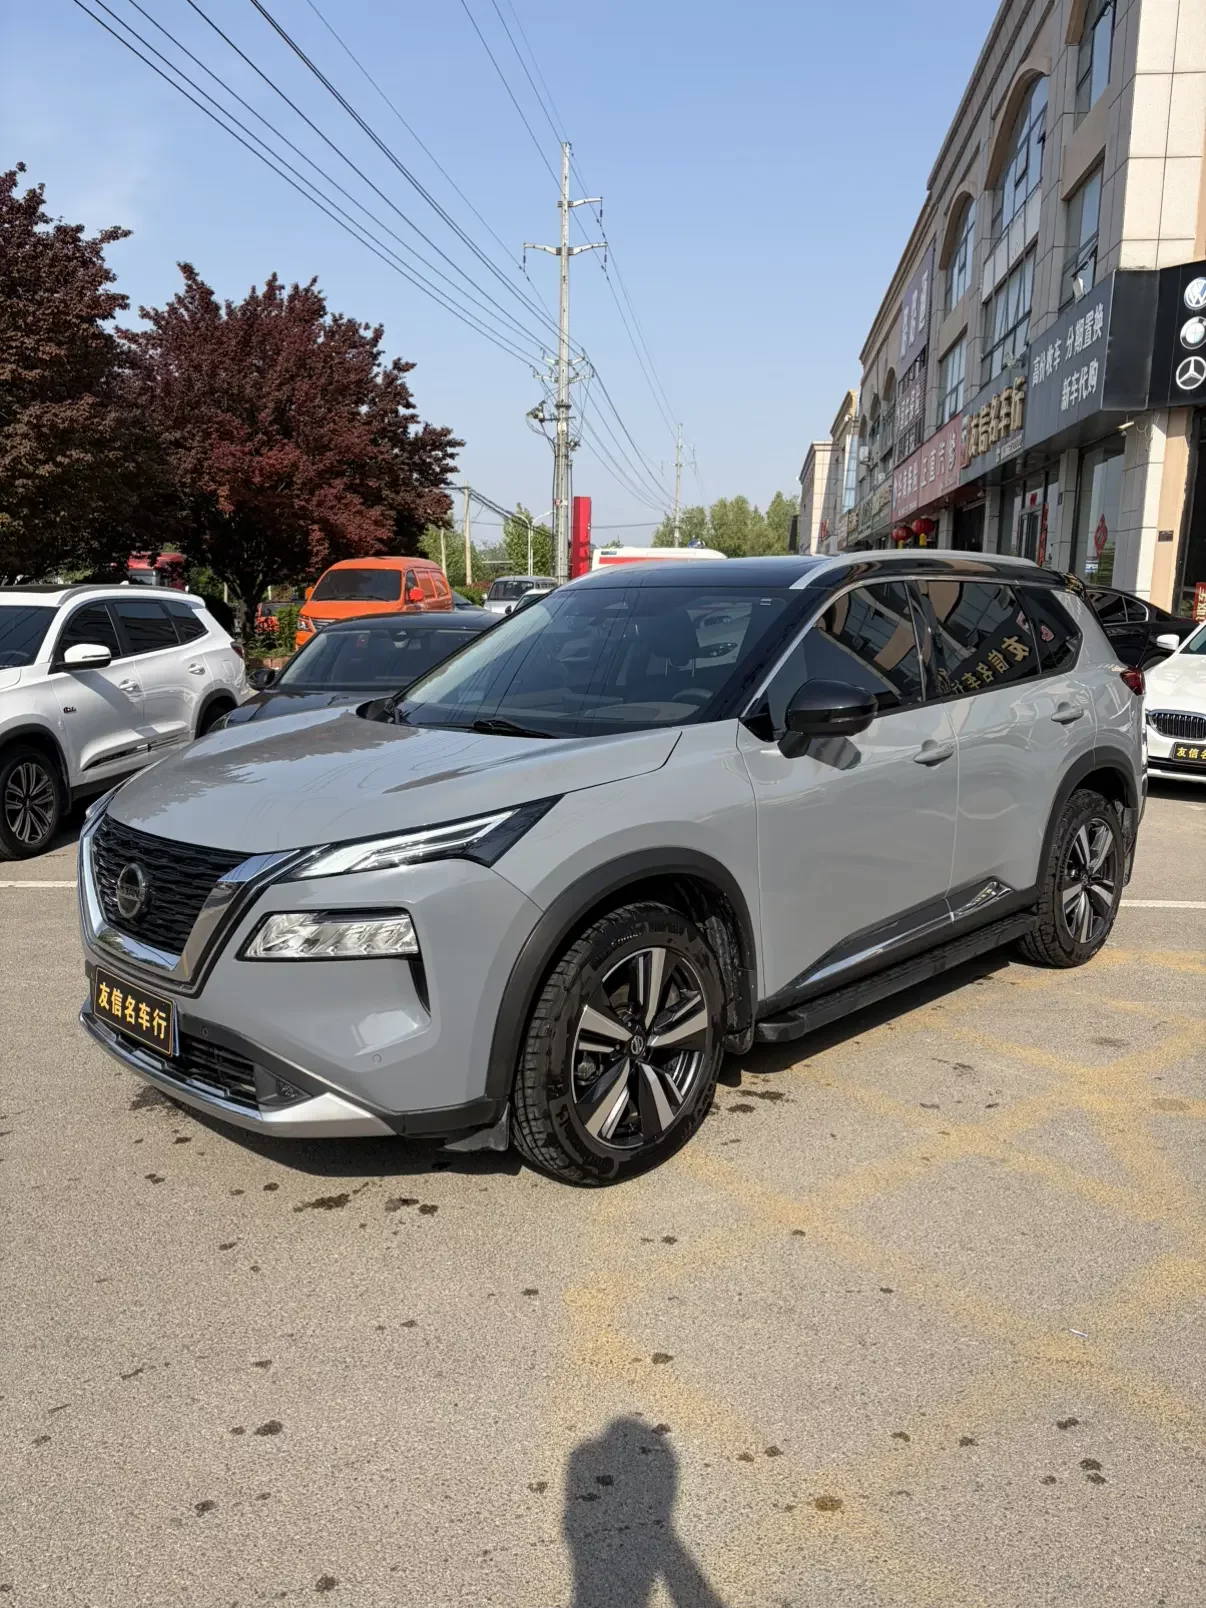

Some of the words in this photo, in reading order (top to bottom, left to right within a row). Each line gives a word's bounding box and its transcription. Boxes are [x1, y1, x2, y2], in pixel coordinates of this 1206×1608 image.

[1060, 358, 1099, 412] 新车代购
[98, 981, 167, 1040] 友信名车行
